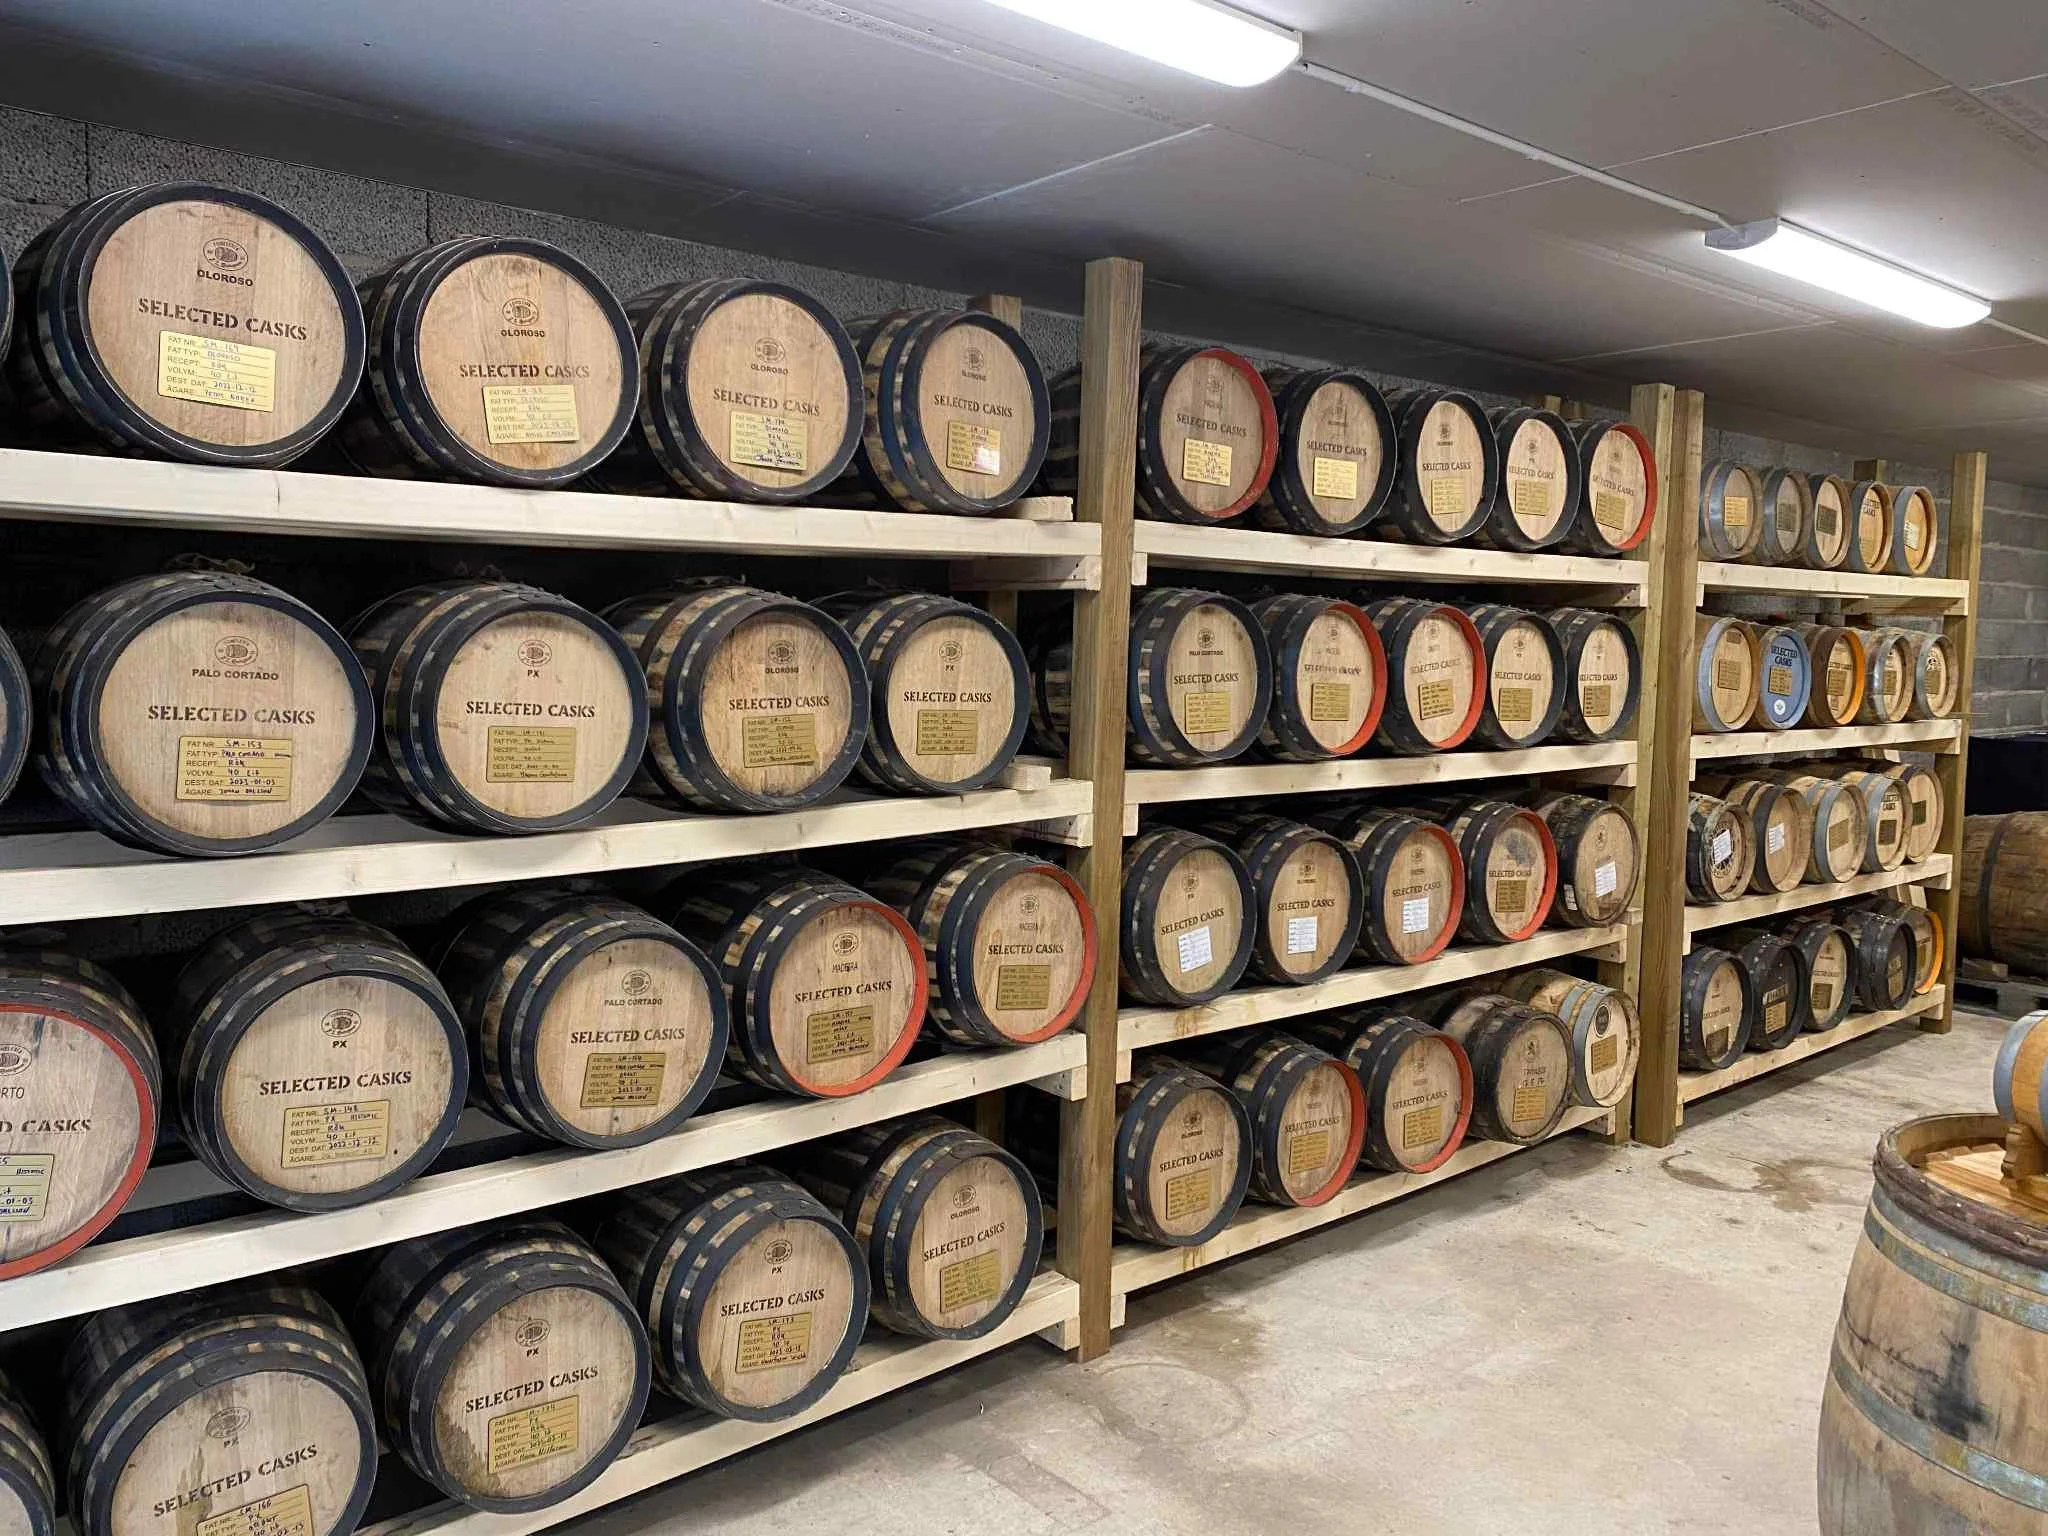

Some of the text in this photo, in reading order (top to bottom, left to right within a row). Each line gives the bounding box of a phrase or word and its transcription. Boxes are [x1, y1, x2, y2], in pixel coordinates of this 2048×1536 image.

[197, 268, 254, 287] OLOROSO
[138, 297, 308, 341] SELECTED CASKS
[500, 328, 545, 338] OLOROSO
[459, 364, 590, 378] SELECTED CASKS
[750, 362, 789, 376] OLOROSO
[713, 387, 821, 417] SELECTED CASKS
[934, 394, 1014, 418] SELECTED CASKS
[1176, 412, 1248, 438] SELECTED CASKS
[1307, 439, 1368, 457] SELECTED CASKS
[1422, 461, 1472, 473] SELECTED CASKS
[191, 668, 279, 681] PALO CORTADO
[527, 669, 540, 679] PX
[765, 666, 800, 675] OLOROSO
[1174, 672, 1240, 685] SELECTED CASKS
[728, 695, 831, 711] SELECTED CASKS
[903, 690, 992, 704] SELECTED CASKS
[148, 705, 316, 726] SELECTED CASKS
[466, 700, 596, 718] SELECTED CASKS
[1392, 885, 1423, 898] SELECTED
[1277, 898, 1336, 912] SELECTED CASKS
[1160, 907, 1225, 936] SELECTED CASKS
[988, 944, 1064, 956] SELECTED CASKS
[795, 980, 893, 1004] SELECTED CASKS
[604, 998, 663, 1007] PALO CORTADO
[570, 1027, 686, 1044] SELECTED CASKS
[332, 1040, 348, 1049] PX
[259, 1070, 413, 1096] SELECTED CASKS
[0, 1086, 25, 1099] RTO
[1392, 1095, 1425, 1111] SELECTED
[21, 1119, 93, 1133] CASKS
[1160, 1146, 1224, 1173] SELECTED CASKS
[950, 1205, 980, 1220] OLOROSO
[923, 1221, 1006, 1263] SELECTED CASKS
[771, 1266, 783, 1275] PX
[720, 1288, 825, 1317] SELECTED CASKS
[526, 1348, 540, 1357] PX
[465, 1366, 599, 1413] SELECTED CASKS
[223, 1438, 239, 1449] PX
[154, 1443, 318, 1517] SELECTED CASKS
